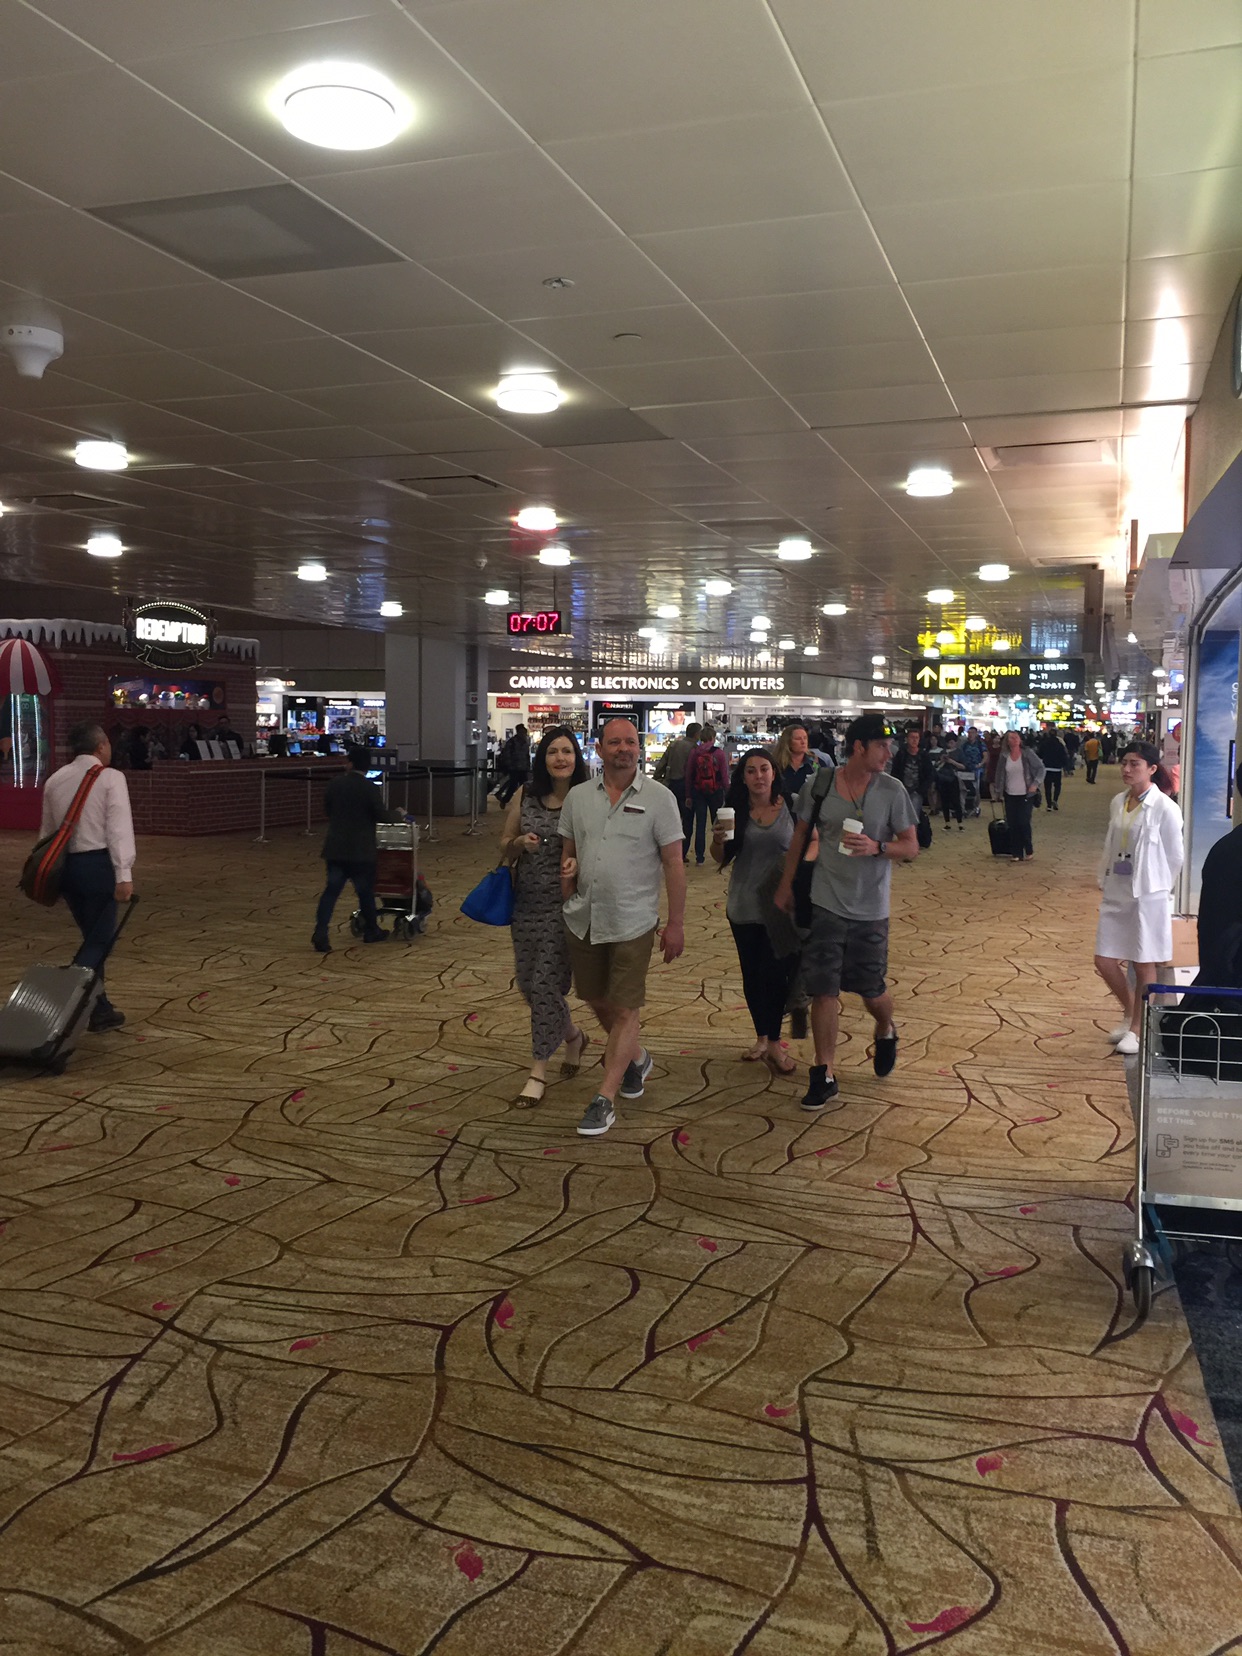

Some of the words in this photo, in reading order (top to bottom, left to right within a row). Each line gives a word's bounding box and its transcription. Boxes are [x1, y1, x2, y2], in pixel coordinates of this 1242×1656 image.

[510, 613, 559, 632] 07:07
[136, 617, 207, 645] REDEMPTION
[968, 664, 1021, 678] Skytrain
[509, 676, 573, 688] CAMERAS
[590, 676, 679, 690] ELECTRONICS
[699, 677, 785, 690] COMPUTERS
[968, 679, 982, 690] to
[982, 678, 997, 690] T1
[1157, 1107, 1190, 1116] BEFORE
[1193, 1110, 1210, 1118] YOU
[1212, 1111, 1229, 1119] GET
[1156, 1116, 1173, 1124] GET
[1176, 1117, 1197, 1126] THIS.
[1183, 1135, 1197, 1143] Sign
